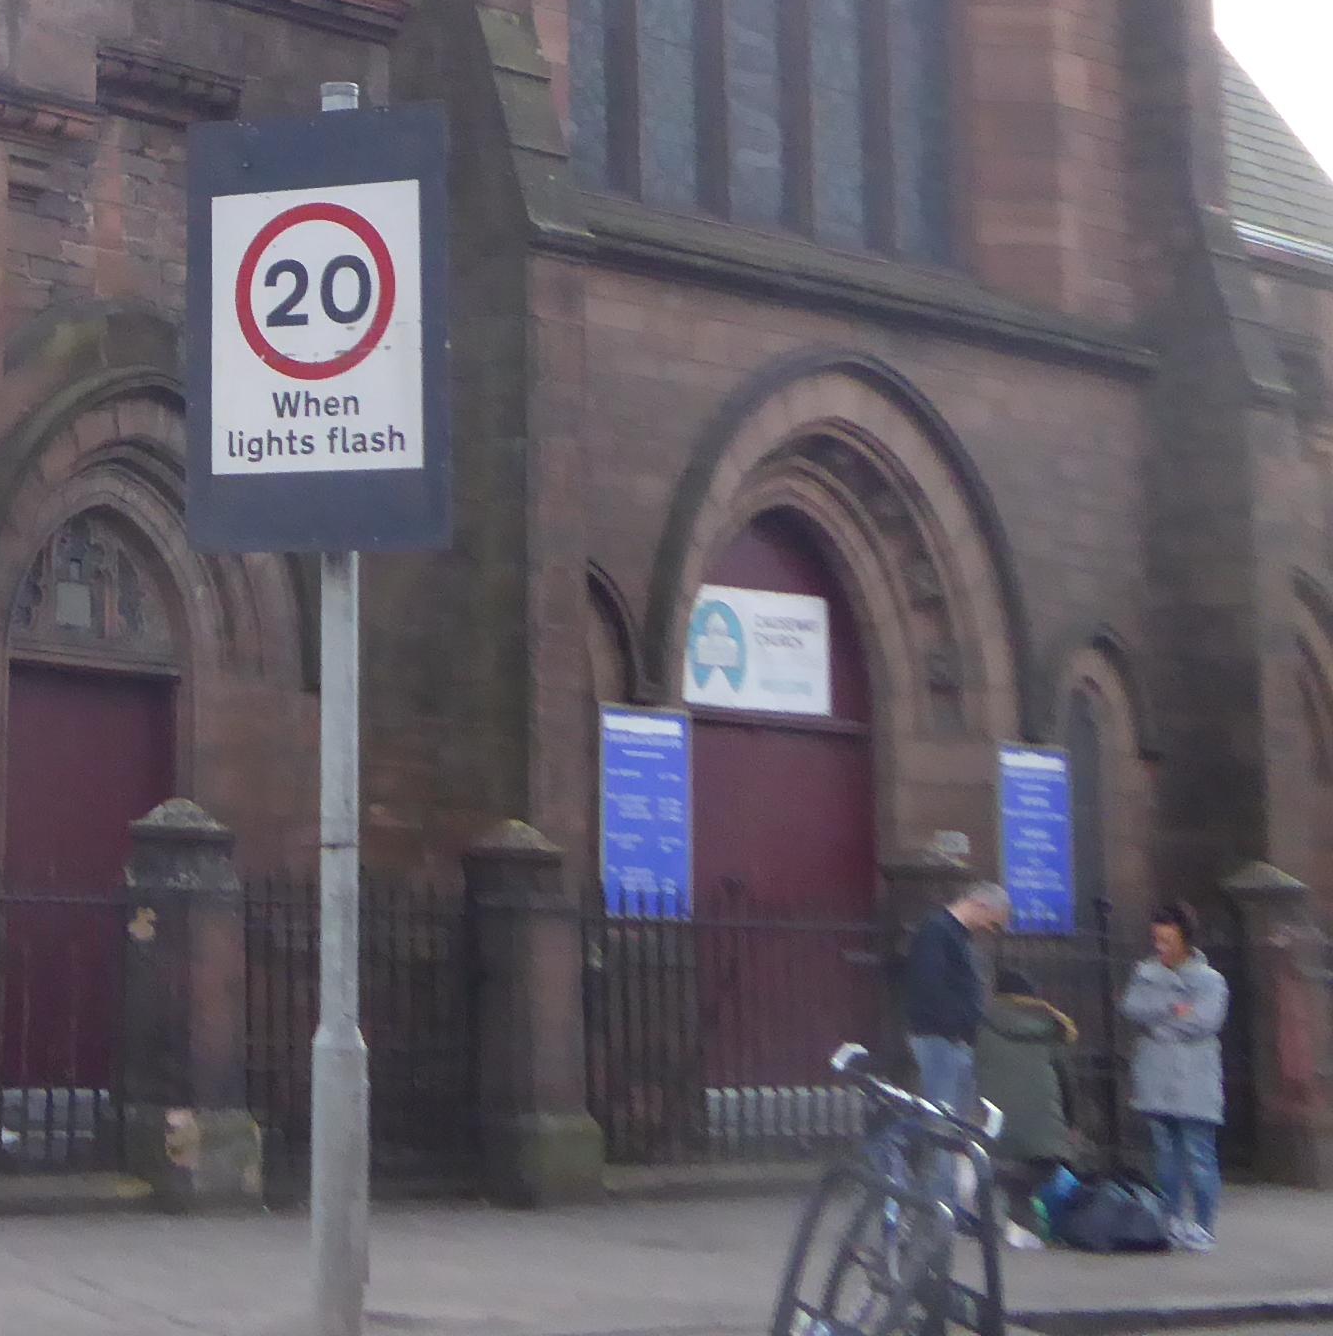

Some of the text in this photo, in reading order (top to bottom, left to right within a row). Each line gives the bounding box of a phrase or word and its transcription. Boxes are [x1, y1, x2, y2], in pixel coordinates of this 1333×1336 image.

[264, 254, 372, 328] 20
[272, 390, 360, 418] When
[227, 424, 405, 462] lights flash
